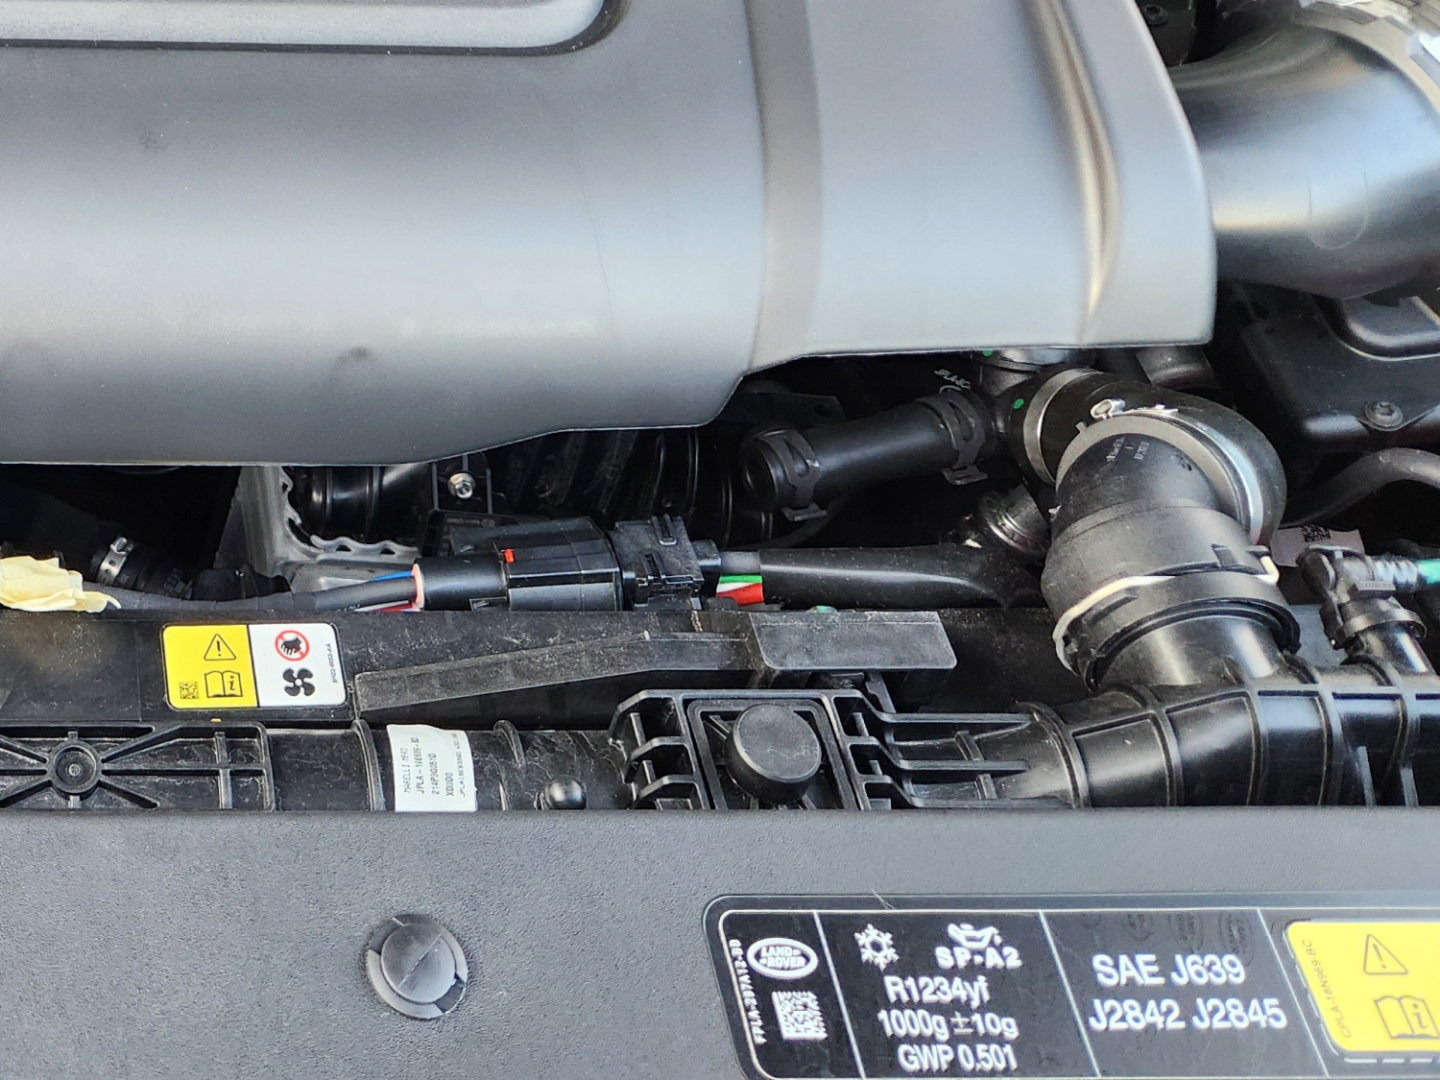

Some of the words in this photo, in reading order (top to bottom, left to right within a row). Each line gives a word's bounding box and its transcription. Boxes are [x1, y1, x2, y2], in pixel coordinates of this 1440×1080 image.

[761, 946, 793, 957] LAND
[766, 957, 806, 969] ROVER
[935, 946, 1023, 970] SP-A2
[1092, 954, 1166, 987] SAE
[1171, 954, 1246, 987] J639
[883, 974, 990, 1010] R1234yf
[877, 1009, 950, 1042] 1000g
[1089, 999, 1186, 1031] J2842
[1192, 997, 1288, 1030] J2845
[898, 1043, 955, 1073] GWP
[958, 1043, 1018, 1072] 0.501
